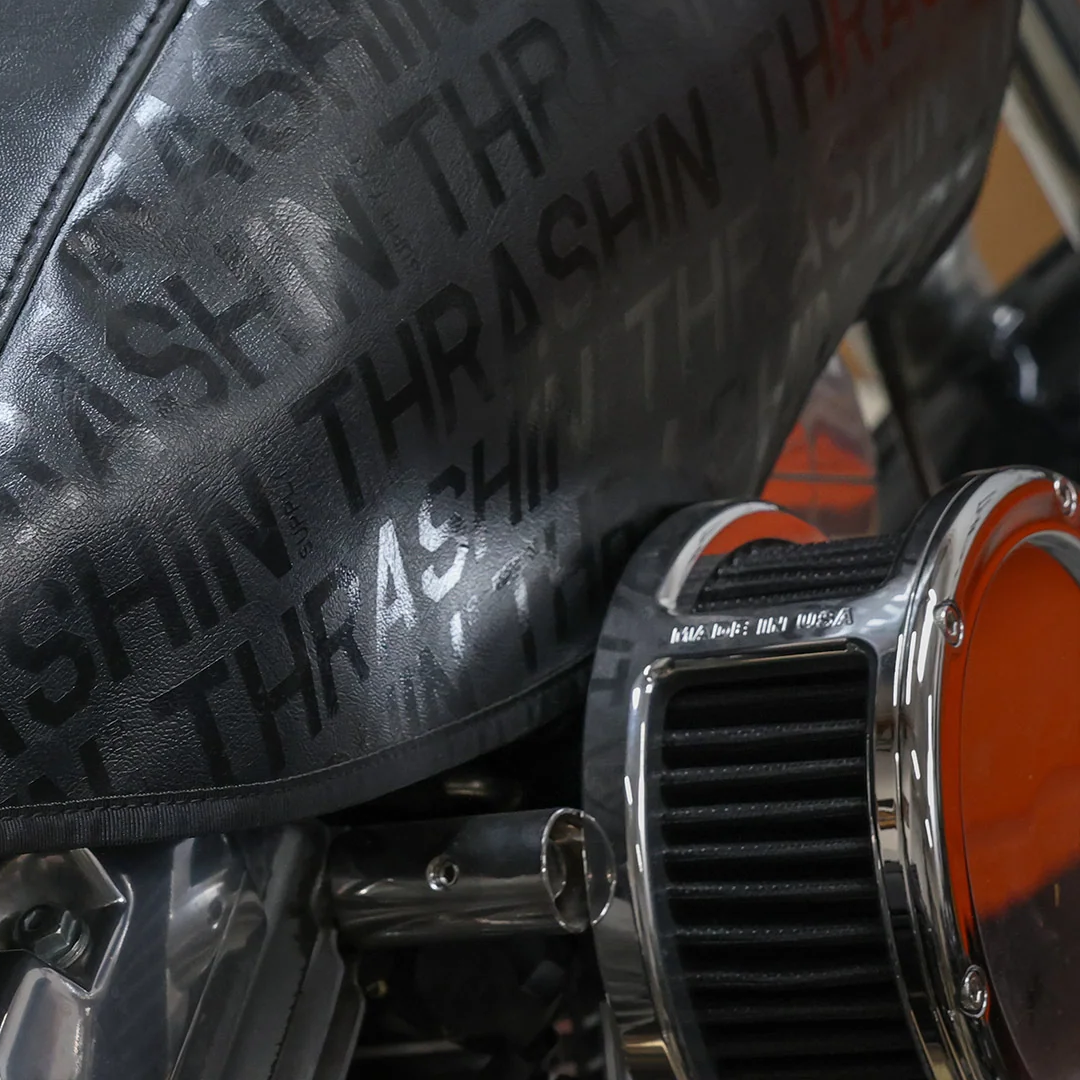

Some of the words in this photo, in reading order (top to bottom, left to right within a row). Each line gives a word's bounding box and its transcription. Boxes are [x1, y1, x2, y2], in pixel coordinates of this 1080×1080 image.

[670, 621, 750, 645] MADE
[756, 615, 789, 636] IN
[796, 606, 855, 630] USA
